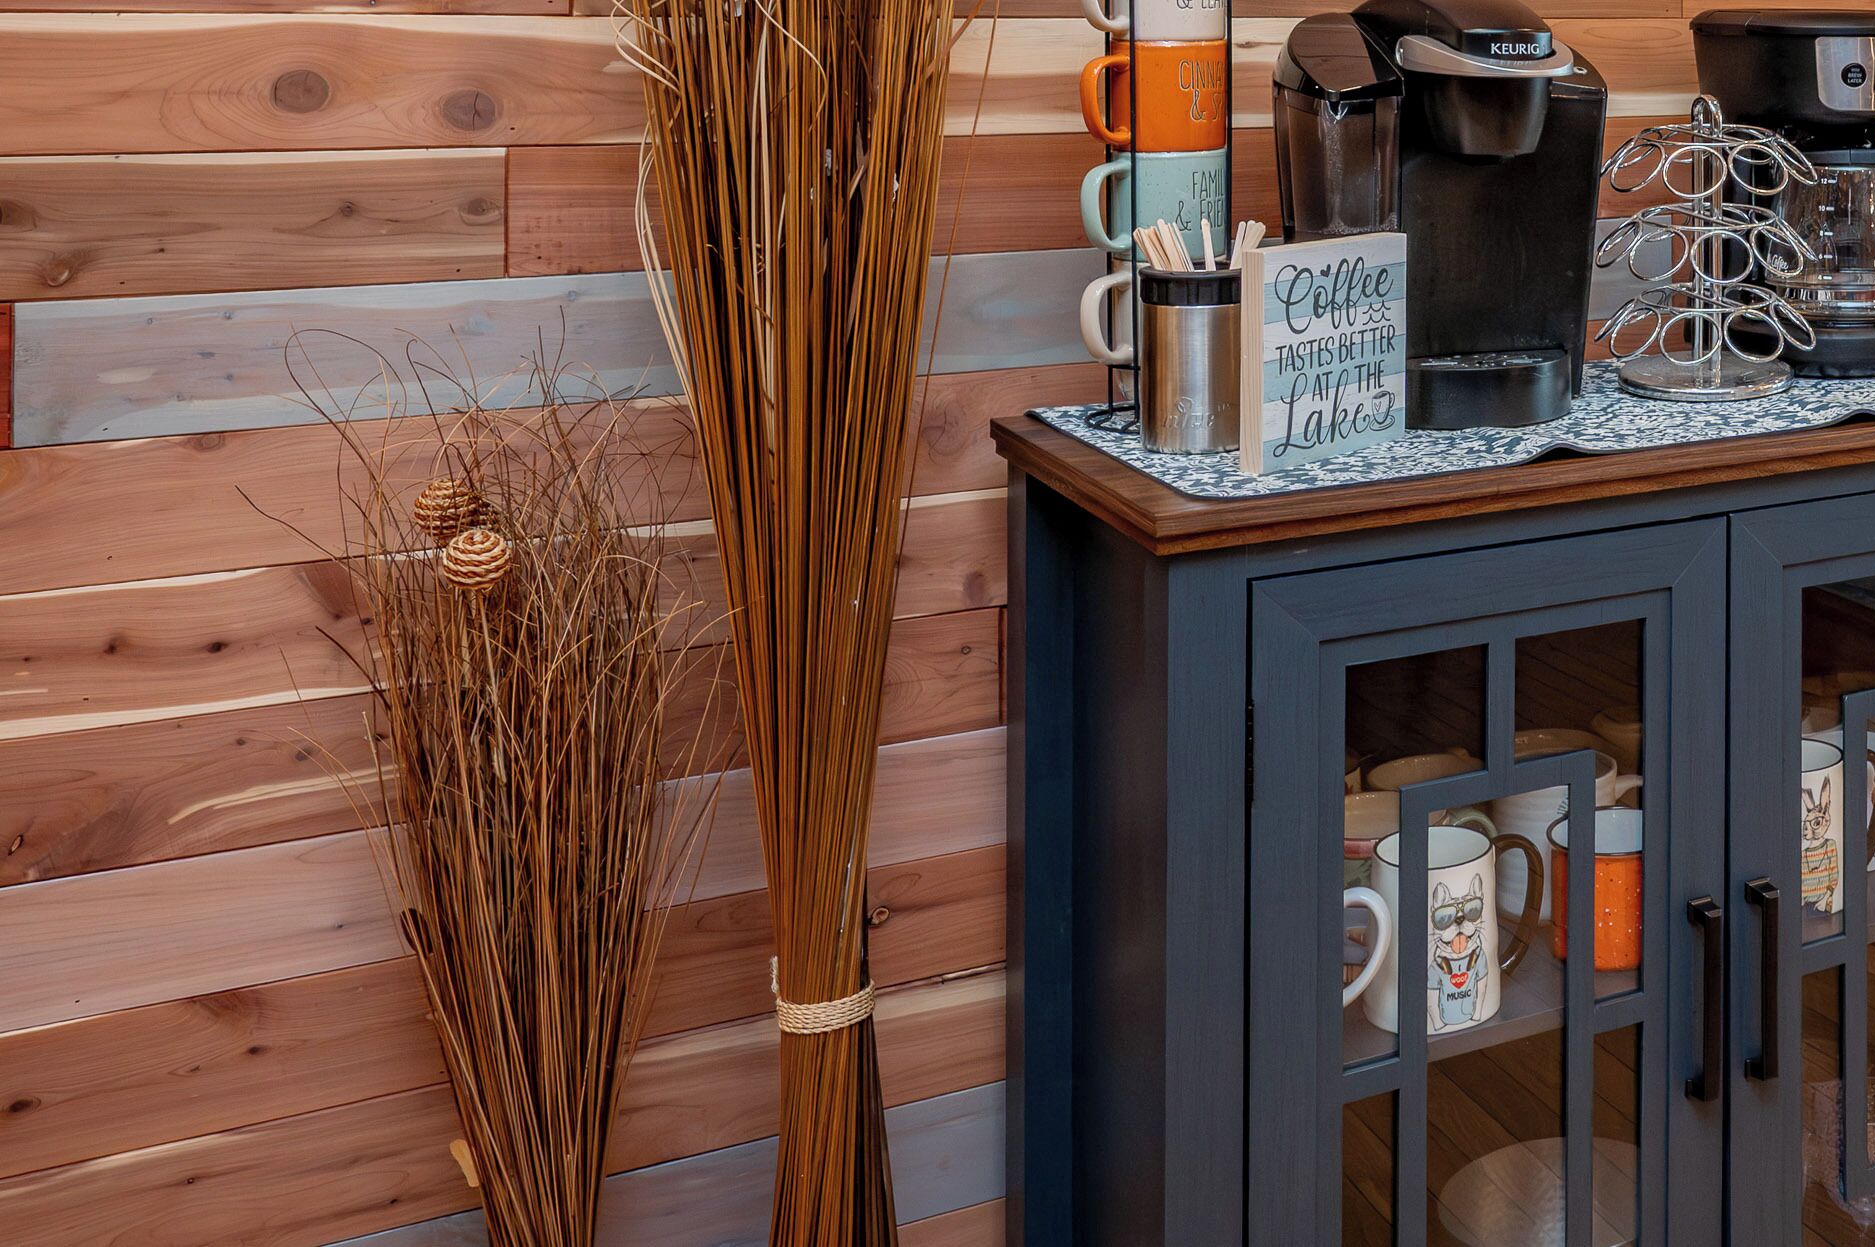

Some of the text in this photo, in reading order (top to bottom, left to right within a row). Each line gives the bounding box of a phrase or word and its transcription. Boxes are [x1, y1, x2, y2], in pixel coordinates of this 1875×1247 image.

[1491, 43, 1540, 55] KEURIG
[1176, 200, 1191, 231] &
[1274, 256, 1394, 334] Coffee
[1275, 324, 1396, 376] TASTES BETTER
[1312, 359, 1385, 402] AT THE
[1273, 368, 1371, 457] Lake
[1446, 989, 1472, 1001] MUSIC
